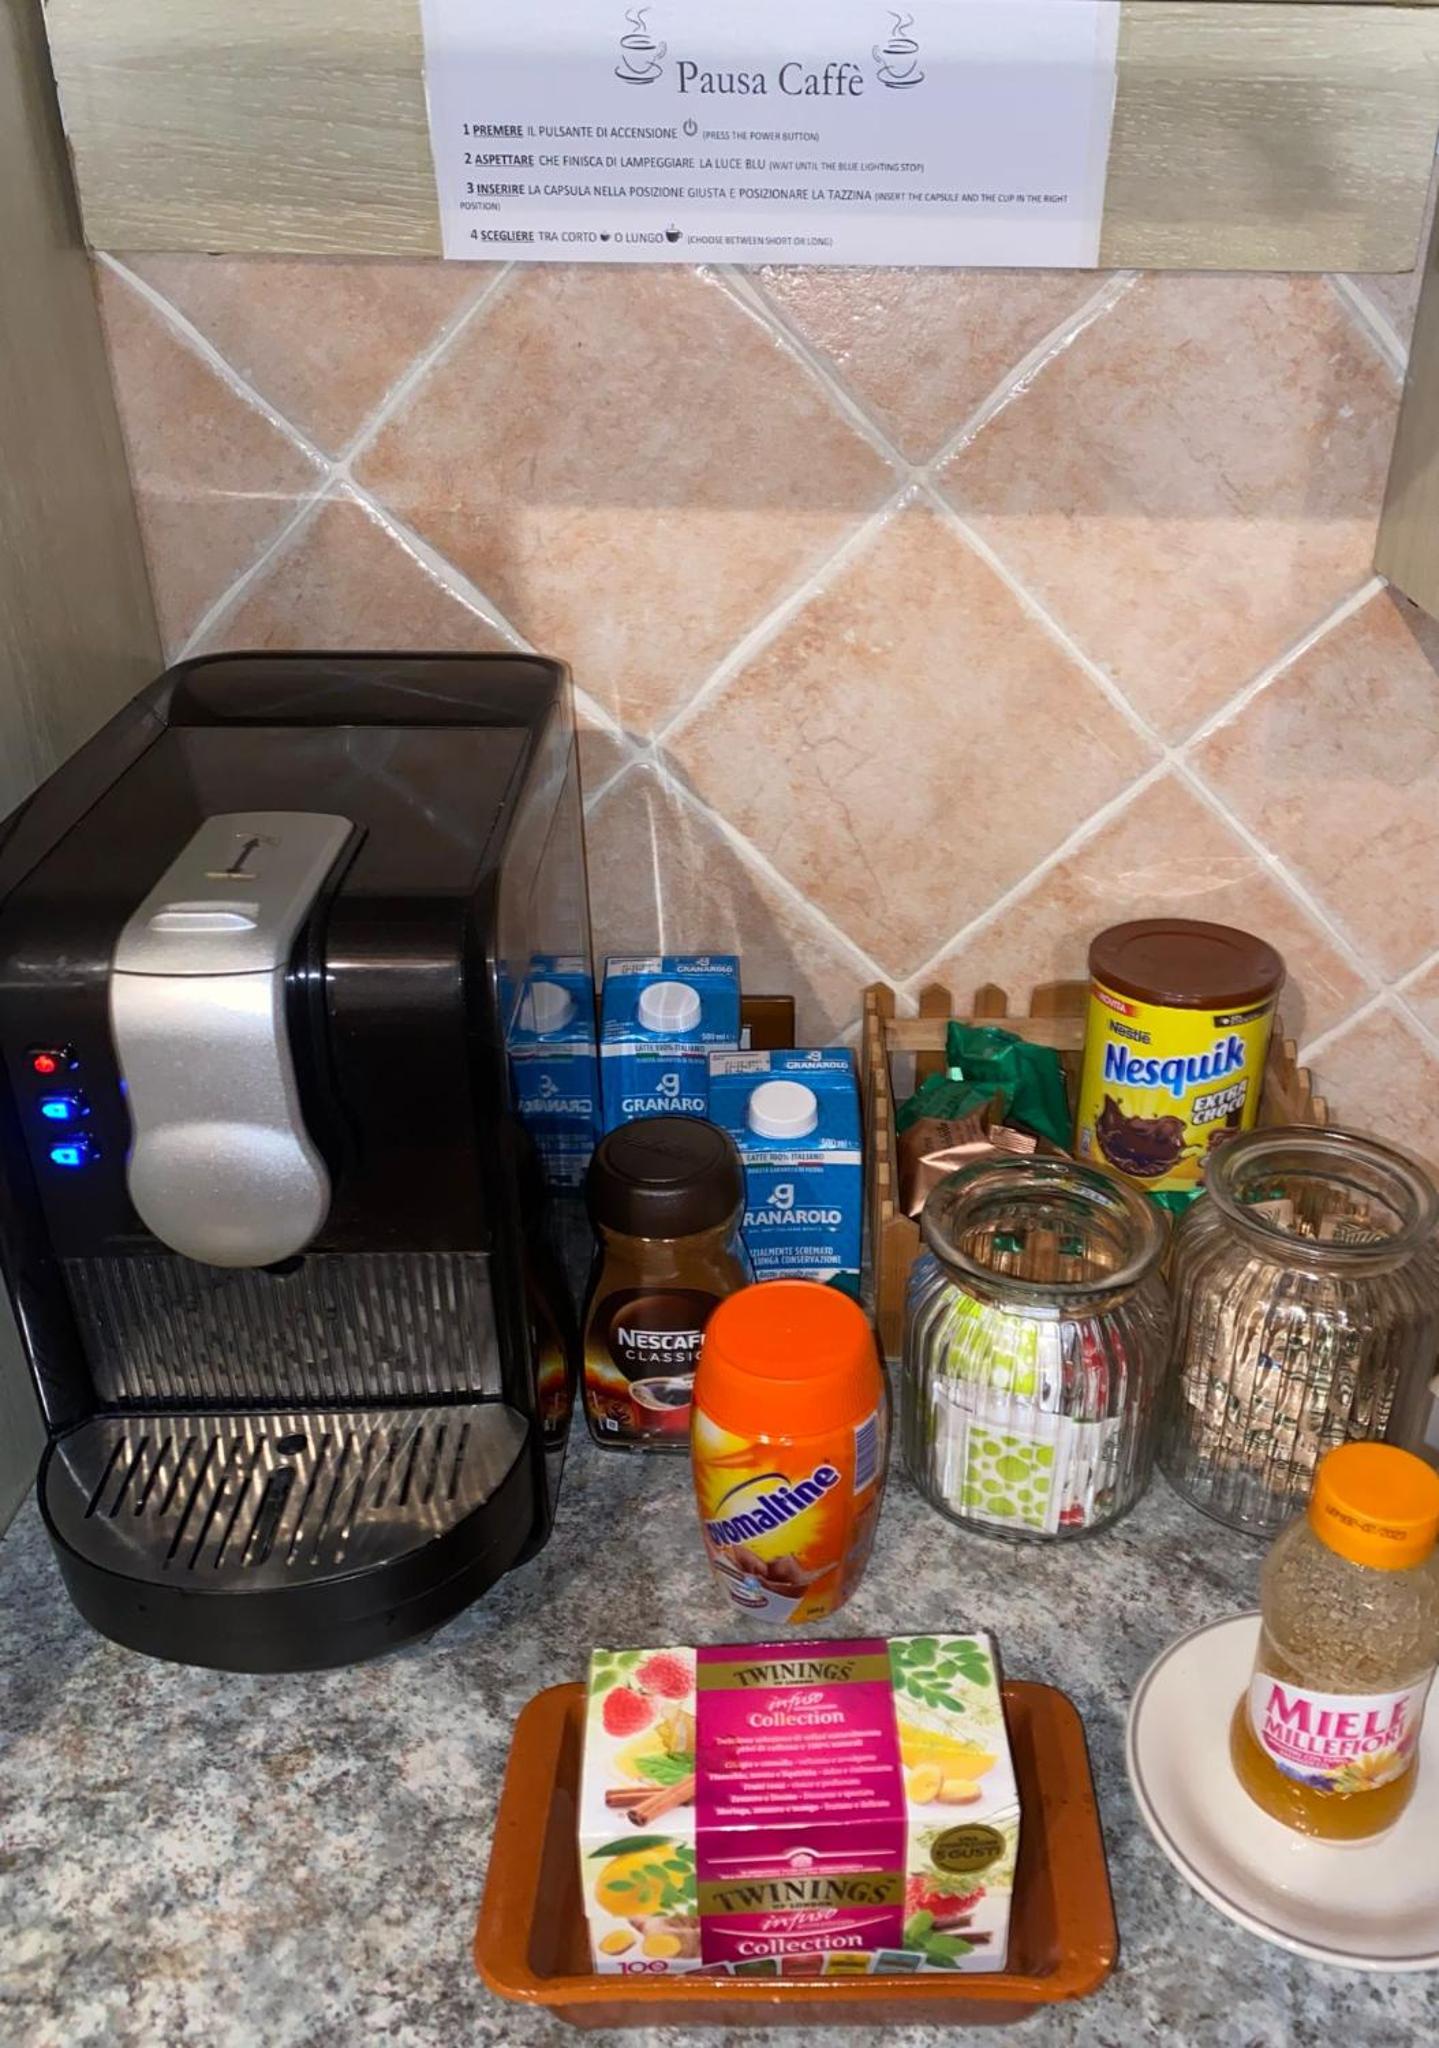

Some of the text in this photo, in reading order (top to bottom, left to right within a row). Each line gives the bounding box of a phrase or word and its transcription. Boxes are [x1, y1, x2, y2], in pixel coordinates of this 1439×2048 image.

[677, 61, 864, 97] Pausa Caffè
[463, 124, 470, 136] 1
[473, 125, 524, 138] PREMERE
[527, 126, 537, 137] IL
[539, 126, 593, 138] PULSANTE
[596, 127, 608, 138] DI
[610, 127, 678, 139] ACCENSIONE
[733, 131, 748, 141] THE
[750, 131, 782, 142] POWER
[782, 132, 820, 143] BUTTON)
[464, 152, 473, 165] 2
[475, 154, 534, 167] ASPETTARE
[538, 155, 560, 167] CHE
[562, 155, 603, 168] FINISCA
[605, 156, 617, 168] DI
[620, 157, 695, 169] LAMPEGGIARE
[699, 158, 713, 169] LA
[715, 158, 742, 170] LUCE
[745, 158, 766, 170] BLU
[795, 161, 818, 171] UNTIL
[820, 162, 836, 171] THE
[838, 162, 859, 172] BLUE
[860, 162, 900, 173] LIGHTING
[466, 182, 475, 195] 3
[476, 184, 525, 197] INSERIRE
[527, 185, 542, 196] LA
[543, 185, 591, 197] CAPSULA
[593, 186, 626, 197] NELLA
[629, 186, 685, 198] POSIZIONE
[687, 187, 727, 199] GIUSTA
[729, 188, 736, 199] E
[739, 188, 809, 200] POSIZIONARE
[811, 189, 825, 200] LA
[828, 189, 872, 201] TAZZINA
[908, 192, 922, 202] THE
[924, 192, 959, 202] CAPSULE
[961, 193, 980, 203] AND
[981, 193, 997, 203] THE
[997, 193, 1015, 203] CUP
[1016, 194, 1026, 203] IN
[1027, 194, 1042, 204] THE
[1043, 194, 1068, 204] RIGHT
[470, 229, 478, 241] 4
[480, 230, 536, 243] SCEGLIERE
[538, 231, 559, 242] TRA
[561, 231, 598, 243] CORTO
[614, 233, 623, 243] O
[625, 233, 665, 244] LUNGO
[785, 1060, 849, 1070] GRANAROLO
[1102, 1035, 1246, 1098] Nesquik
[1192, 1076, 1249, 1113] EXTRA
[621, 1098, 707, 1113] GRANARO
[1192, 1093, 1247, 1126] CHOCO
[746, 1152, 769, 1162] LATTE
[791, 1152, 825, 1161] ITALIANO
[743, 1209, 843, 1227] RANAROLO
[781, 1254, 842, 1266] CONSERVAZIONE
[795, 1246, 834, 1257] SCREMATO
[733, 1662, 853, 1687] TWININGS
[748, 1711, 845, 1729] Collection
[1266, 1683, 1410, 1739] MIELE
[1265, 1715, 1404, 1756] MILLEFIORI
[948, 1844, 1002, 1859] GUSTI
[712, 1878, 891, 1912] TWININGS
[761, 1907, 839, 1932] infuso
[737, 1934, 864, 1956] Collection
[616, 1959, 669, 1977] 100
